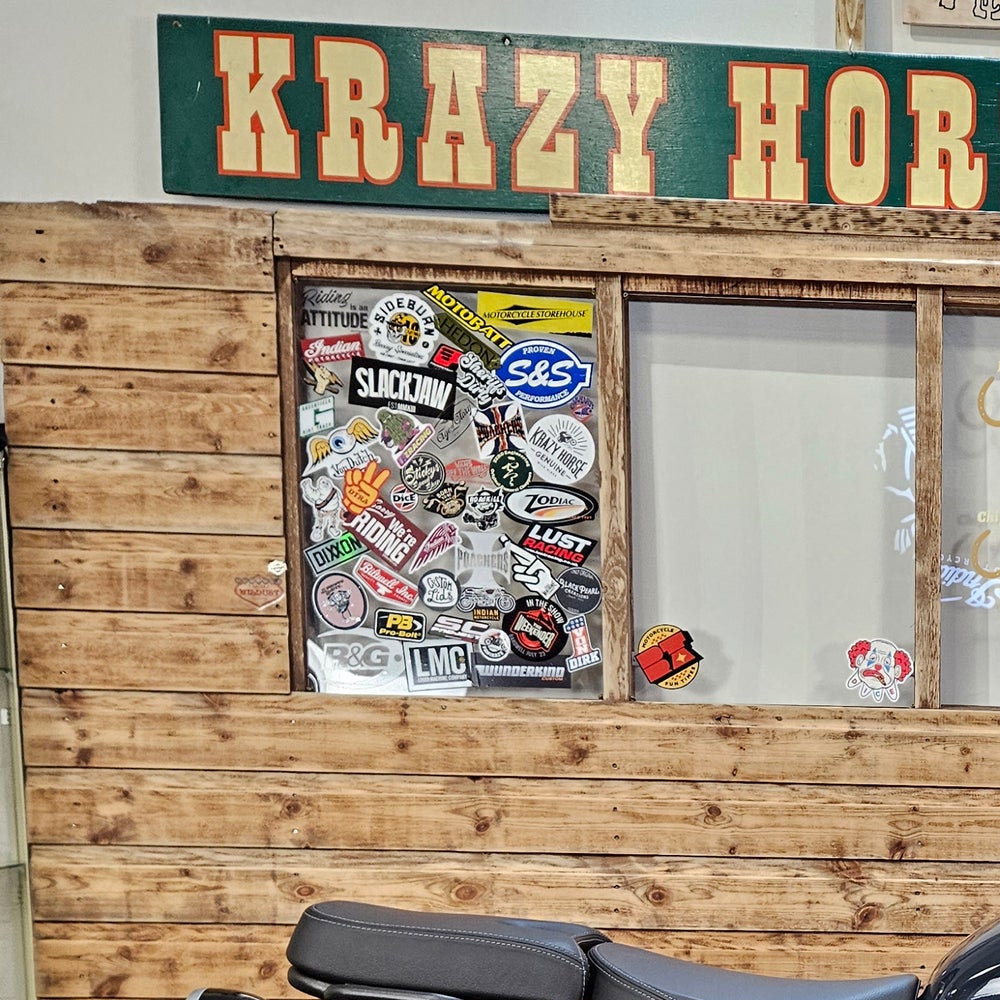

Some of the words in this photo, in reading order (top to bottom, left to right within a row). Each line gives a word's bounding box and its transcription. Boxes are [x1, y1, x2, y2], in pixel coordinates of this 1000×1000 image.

[213, 29, 668, 196] KRAZY
[303, 289, 352, 308] Riding
[301, 309, 369, 329] ATTITUDE
[374, 297, 435, 337] SIDEBURN
[426, 284, 514, 350] MOTOBATT
[483, 310, 535, 319] MOTORCYCLE
[536, 309, 587, 318] STOREHOUSE
[303, 339, 361, 358] Indian
[522, 345, 556, 355] PROVEN
[505, 359, 574, 388] S&S
[355, 366, 453, 411] SLACKJAW
[514, 389, 570, 403] PERFORMANCE
[529, 426, 559, 456] KRAZY
[557, 449, 588, 480] HORSE
[535, 451, 566, 477] GENUINE
[524, 493, 574, 514] ZODIAC
[348, 510, 411, 565] RIDING
[388, 517, 417, 547] We're
[528, 524, 592, 553] LUST
[313, 536, 363, 567] DIXXON
[522, 537, 585, 563] RACING
[559, 578, 579, 592] BLACK
[579, 585, 600, 595] PEARL
[386, 613, 414, 631] PB
[525, 598, 535, 608] IN
[535, 598, 548, 609] THE
[548, 604, 565, 624] SHOW
[514, 614, 556, 648] WEEKENDER
[641, 627, 675, 648] MOTORCYCLE
[324, 642, 391, 669] R&G
[413, 645, 467, 677] LMC
[569, 651, 600, 670] DIRK
[475, 664, 566, 678] WUNDERKIND
